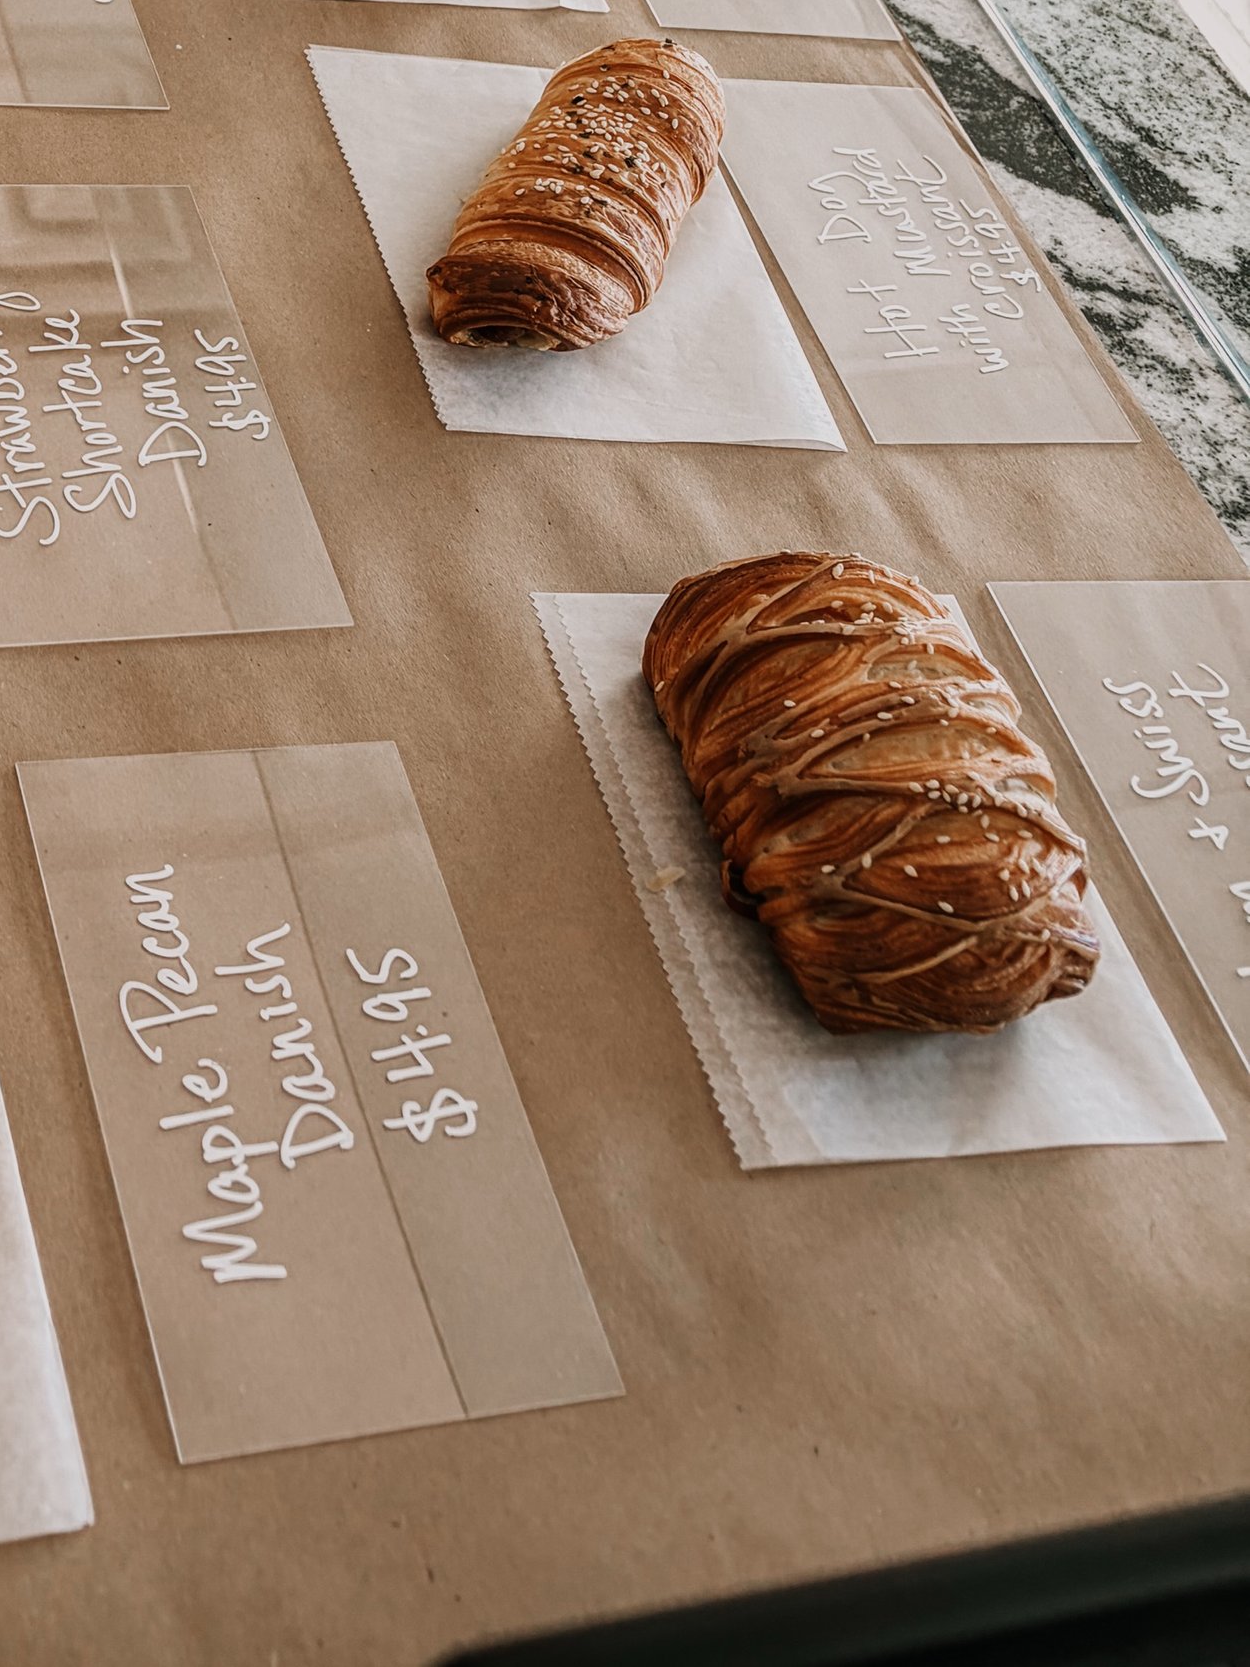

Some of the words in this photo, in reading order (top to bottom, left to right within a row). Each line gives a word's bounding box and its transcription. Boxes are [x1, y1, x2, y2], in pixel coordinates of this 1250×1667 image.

[808, 170, 872, 245] Dog
[833, 146, 951, 276] Mustard
[959, 199, 1042, 293] $4.95
[847, 279, 939, 359] Hot
[938, 303, 1010, 374] with
[28, 308, 137, 519] Shortcake
[100, 319, 207, 467] Danish
[194, 329, 271, 440] $4.95
[1103, 677, 1210, 806] Swiss
[119, 864, 217, 1063] Pecan
[214, 923, 354, 1169] Danish
[345, 947, 478, 1141] $4.95
[159, 1057, 287, 1283] Maple
